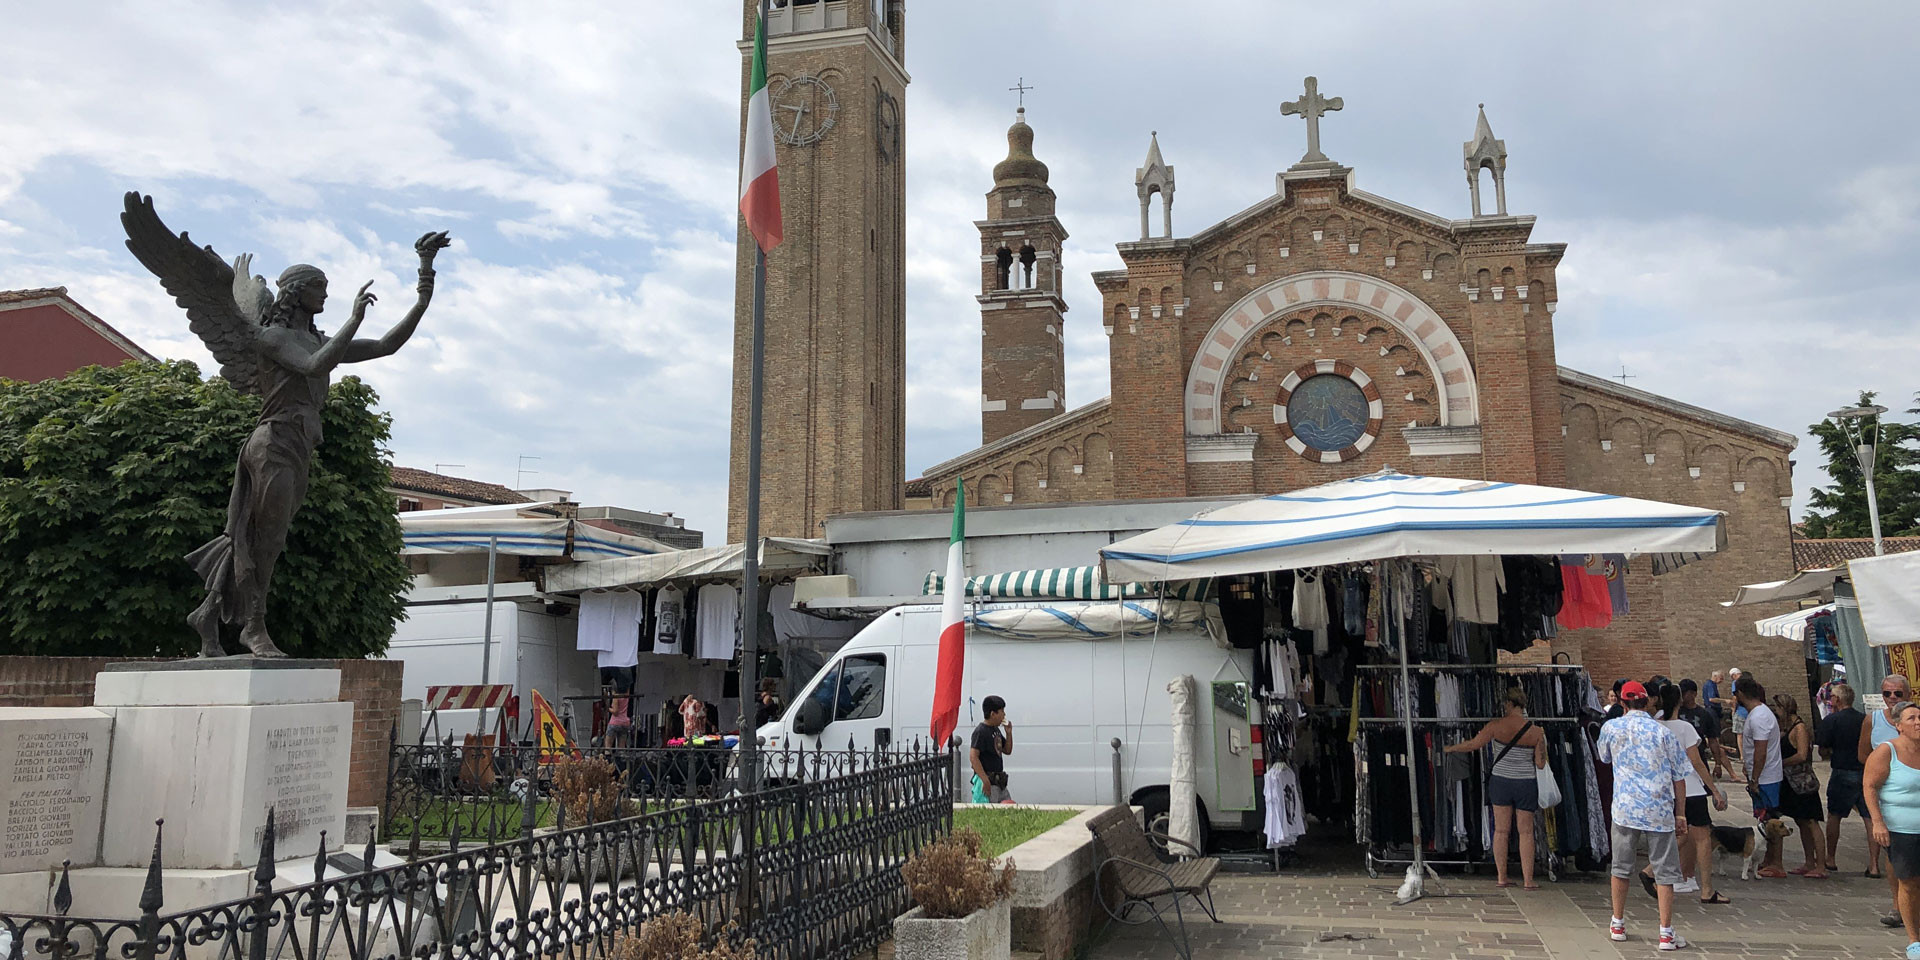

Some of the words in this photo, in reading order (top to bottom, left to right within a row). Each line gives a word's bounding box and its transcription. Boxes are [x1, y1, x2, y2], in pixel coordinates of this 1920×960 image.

[54, 740, 79, 748] PIETRO
[16, 749, 62, 758] TAGLIAPIETRA
[14, 758, 44, 766] ZAMBON
[53, 757, 85, 765] ARDUINO
[13, 766, 44, 775] ZANELLA
[12, 774, 43, 783] ZANELLA
[46, 773, 71, 781] PIETRO
[20, 791, 36, 799] PER
[37, 789, 72, 798] MALATTIA
[9, 799, 46, 808] BACCIOLO
[49, 796, 92, 805] FERDINANDO
[8, 807, 45, 816] BACCIOLO
[48, 806, 67, 814] LUIGI
[39, 813, 71, 822] GIOVANNI
[6, 824, 38, 833] DORIZZA
[40, 821, 70, 831] GIUSEPPE
[5, 832, 39, 841] TORTATO
[42, 829, 74, 839] GIOVANNI
[41, 837, 73, 846] GIORGIO
[4, 850, 17, 859] VIO
[20, 847, 49, 857] ANGELO
